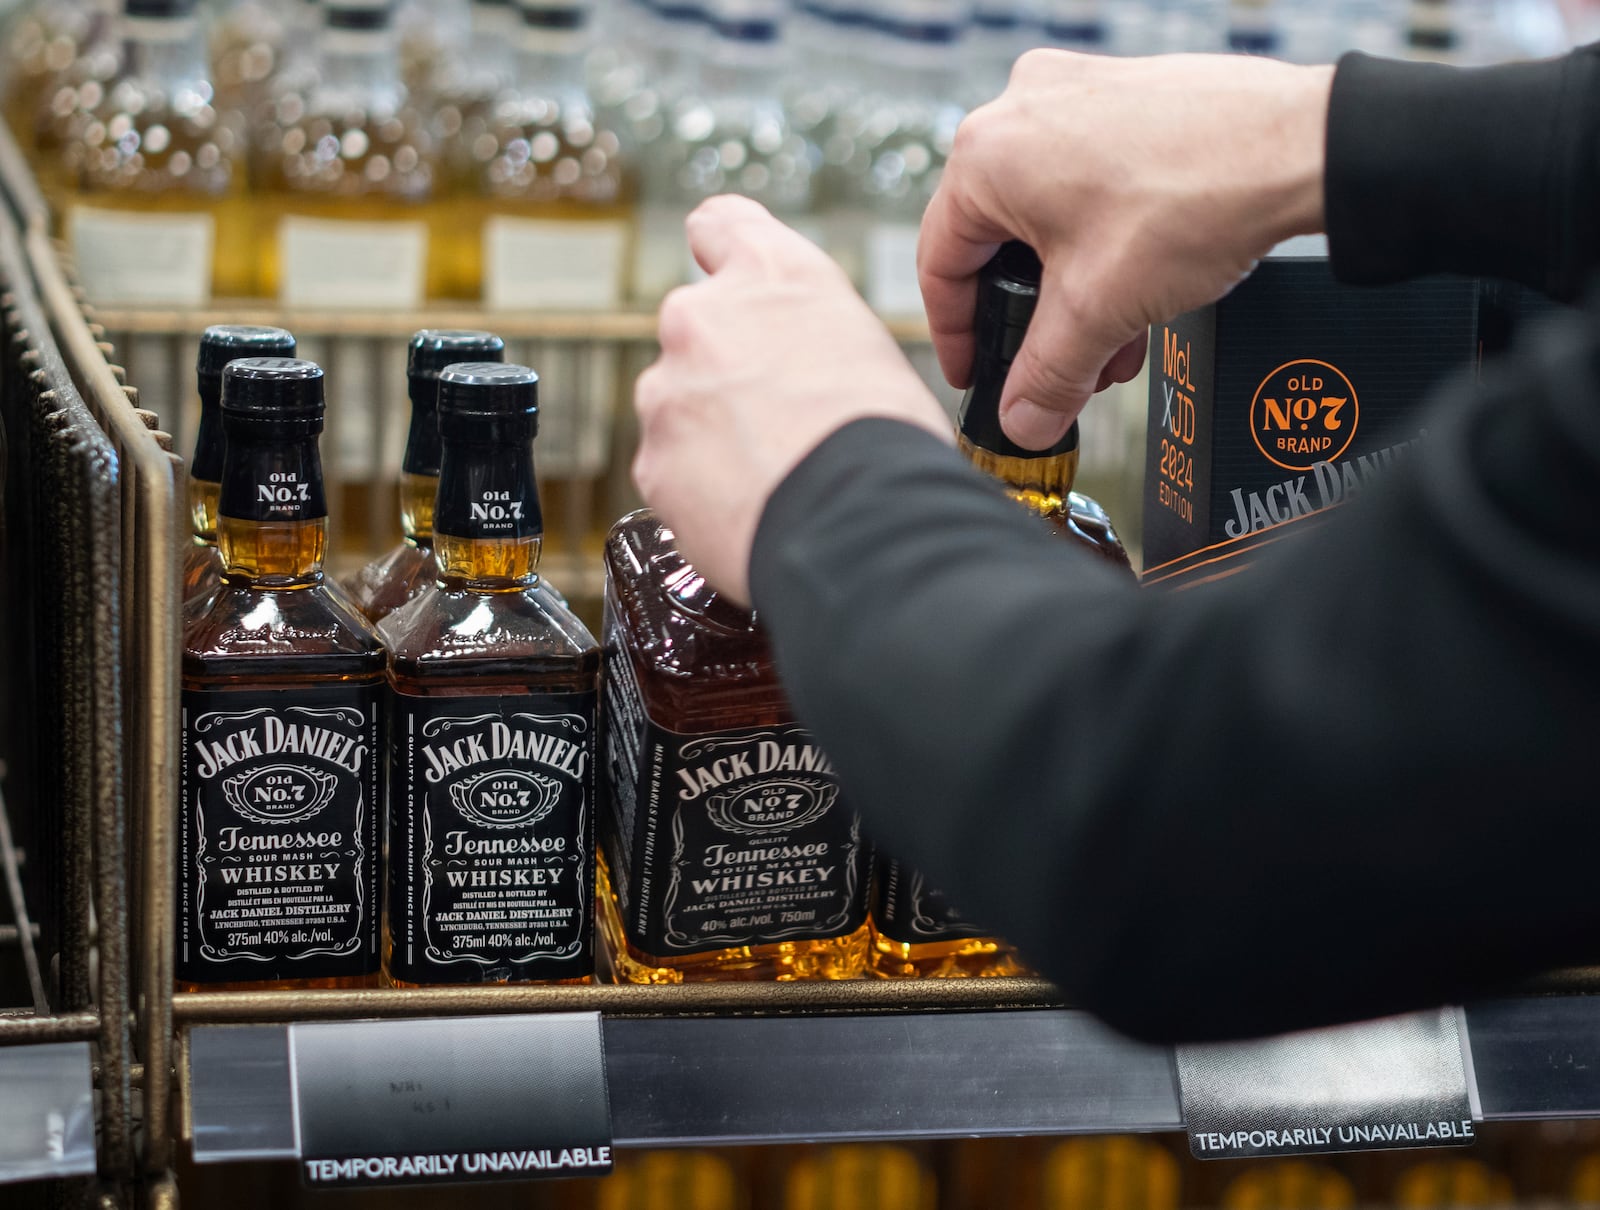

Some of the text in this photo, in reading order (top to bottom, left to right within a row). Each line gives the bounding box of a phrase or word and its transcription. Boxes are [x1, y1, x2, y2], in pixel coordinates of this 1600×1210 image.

[1163, 327, 1195, 393] McL
[1288, 375, 1323, 391] OLD
[1277, 437, 1332, 453] BRAND
[1160, 438, 1193, 493] 2024
[269, 473, 297, 482] Old
[483, 491, 510, 501] Old
[1160, 481, 1193, 524] EDITION
[194, 716, 369, 779] JACK DANIEL'S
[421, 722, 590, 783] JACK DANIEL'S
[266, 775, 293, 785] Old
[676, 751, 755, 800] JACK
[253, 785, 306, 803] No.7
[492, 780, 518, 790] Old
[762, 788, 786, 796] OLD
[480, 790, 531, 808] No.7
[748, 811, 794, 822] BRAND
[219, 826, 342, 852] Tennessee
[445, 831, 566, 855] Tennessee
[249, 853, 313, 863] SOUR MASH
[474, 858, 502, 867] SOUR
[703, 842, 828, 867] Tennessee
[220, 863, 340, 884] WHISKEY
[712, 859, 818, 876] SOUR MASH
[446, 868, 564, 888] WHISKEY
[691, 866, 836, 895] WHISKEY
[237, 888, 272, 896] DISTILLED
[281, 886, 312, 894] BOTTLED
[462, 891, 497, 899] DISTILLED
[538, 889, 547, 897] BY
[683, 890, 836, 913] JACK DANIEL DISTILLERY
[210, 904, 351, 920] JACK DANIEL DISTILLERY
[436, 908, 574, 922] JACK DANIEL DISTILLERY
[701, 919, 727, 931] 40%
[780, 910, 815, 923] 750ml
[261, 918, 304, 927] TENNESSEE
[485, 922, 528, 930] TENNESSEE
[227, 928, 334, 946] 375ml 40% alc./vol.
[452, 932, 556, 948] 375ml 40% alc./vol.
[1196, 1120, 1475, 1151] TEMPORARILY UNAVAILABLE
[306, 1146, 611, 1181] TEMPORARILY UNAVAILABLE
